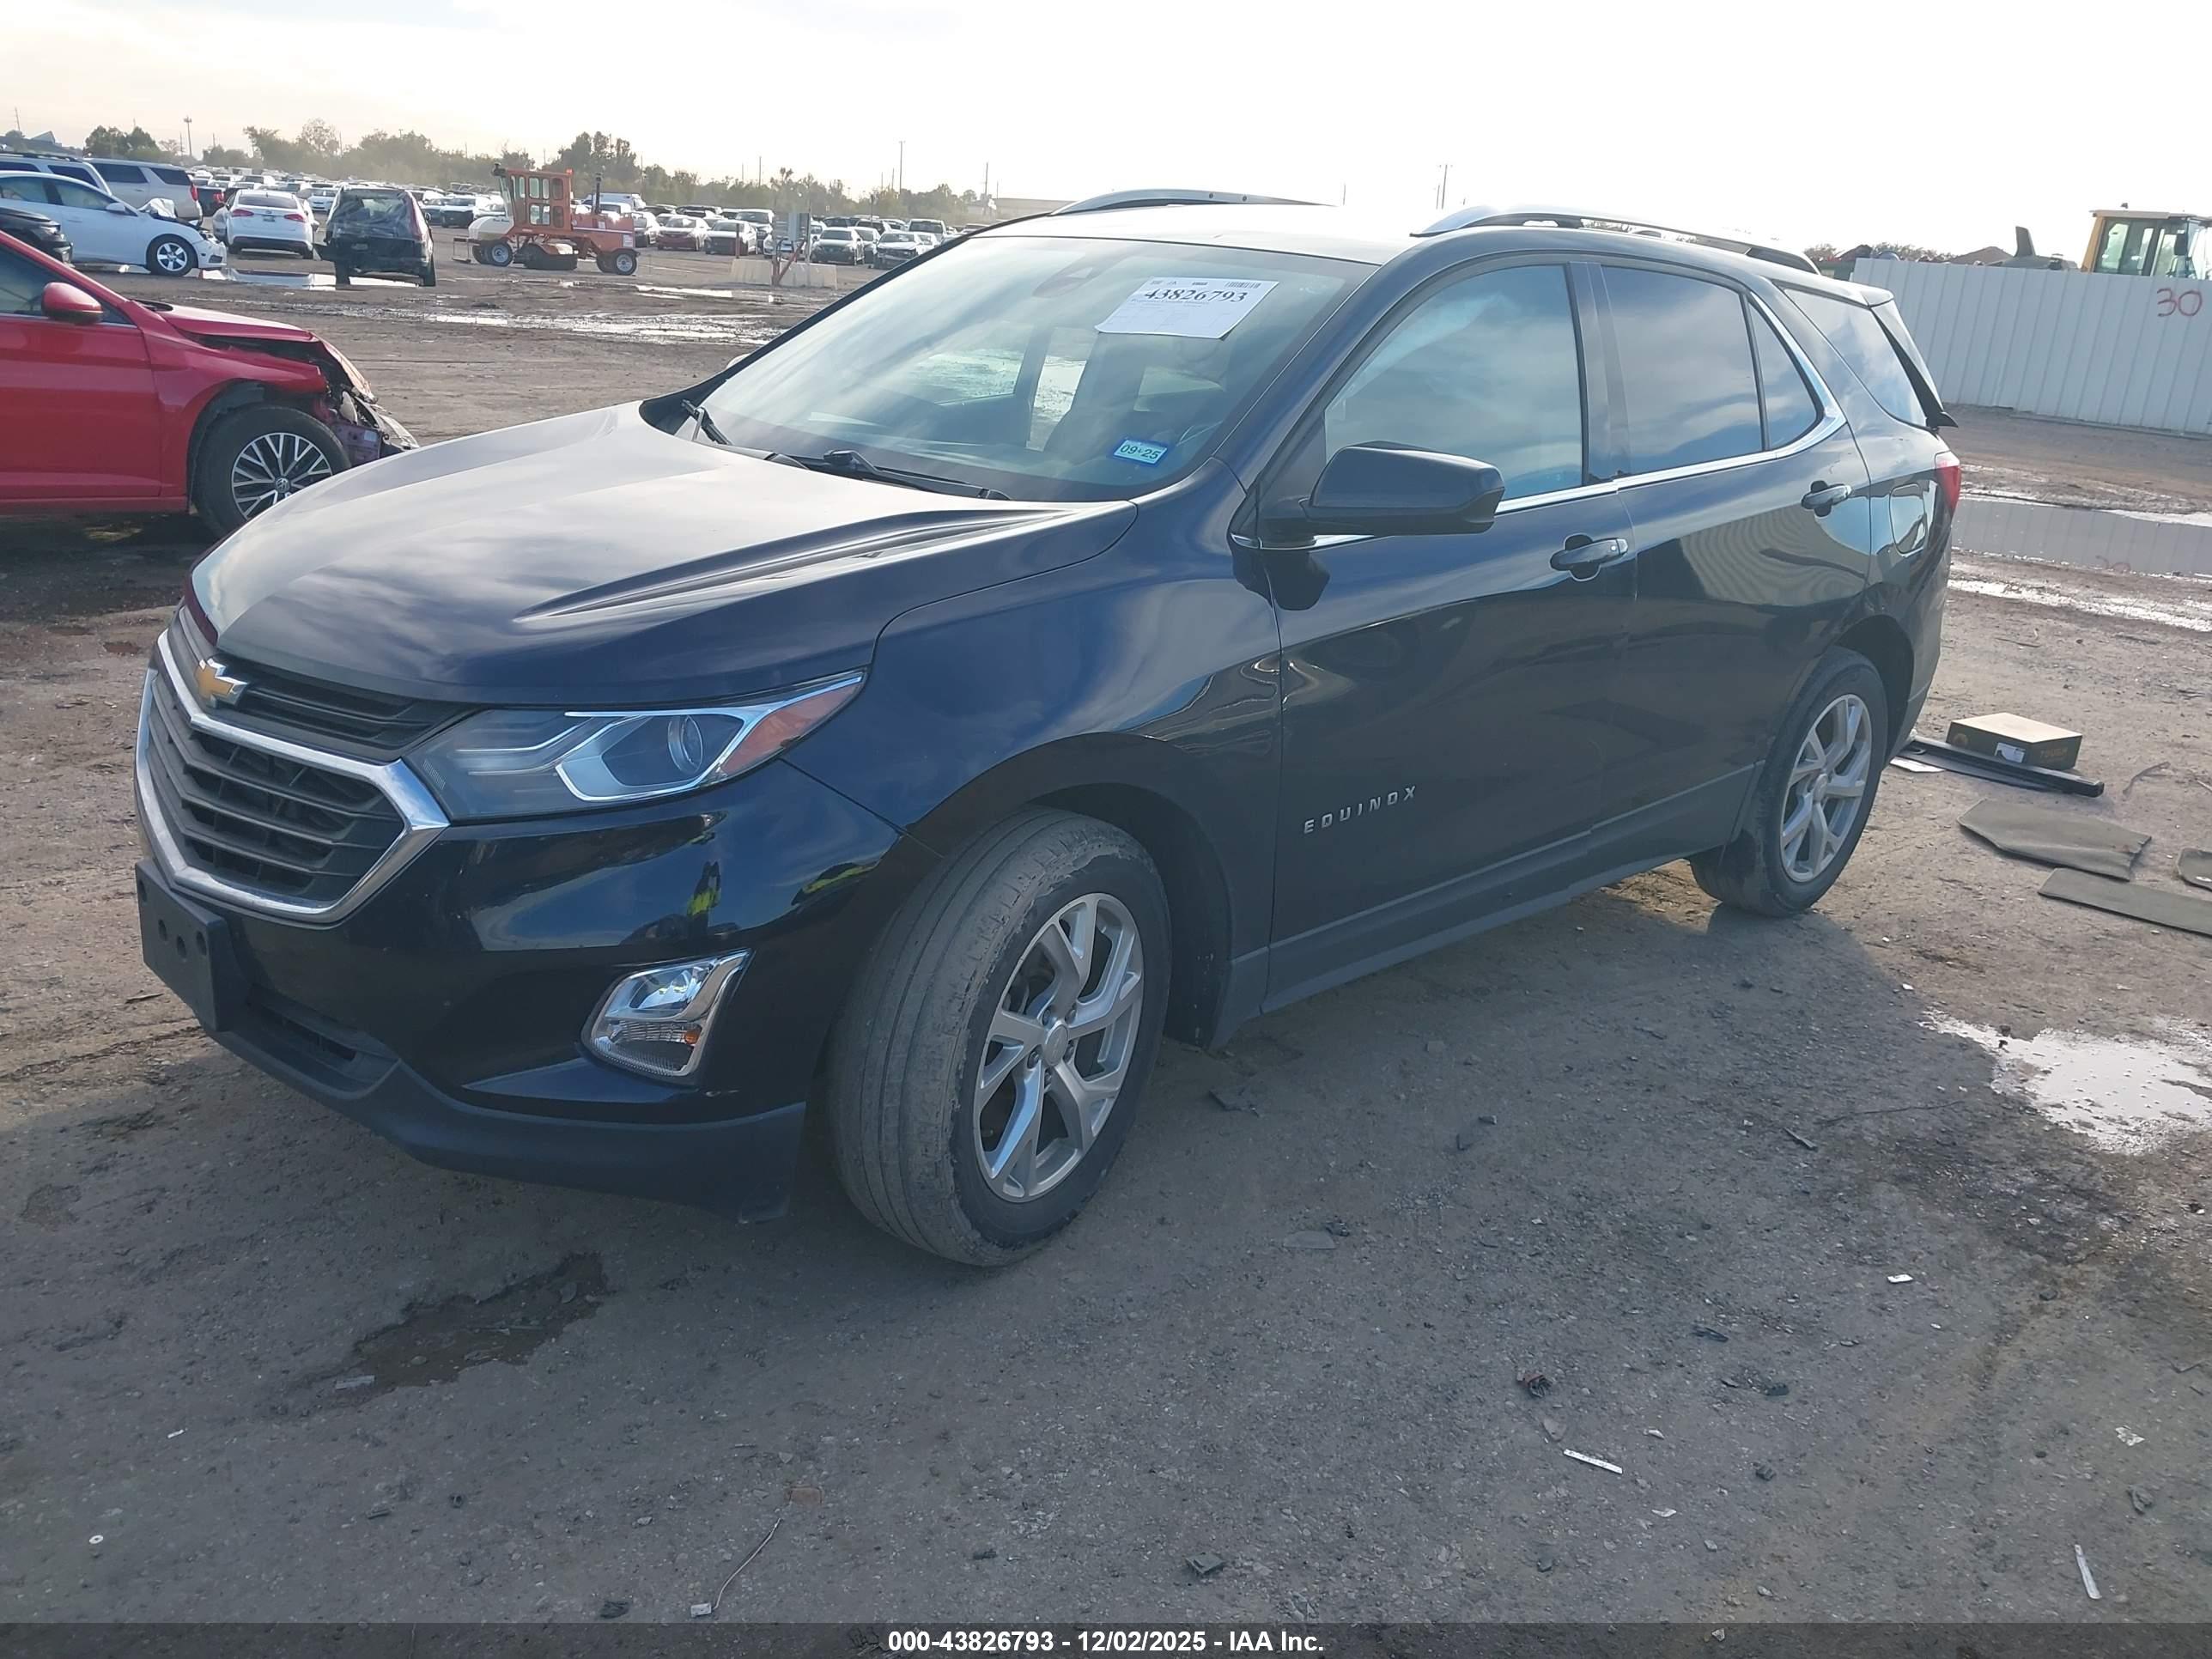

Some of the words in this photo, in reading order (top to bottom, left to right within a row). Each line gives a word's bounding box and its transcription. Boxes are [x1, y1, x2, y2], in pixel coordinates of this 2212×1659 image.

[1145, 288, 1248, 302] 43826793
[2156, 287, 2203, 317] 30
[1120, 444, 1139, 454] 09
[1140, 448, 1162, 459] 25
[1304, 785, 1416, 834] EQUINOX
